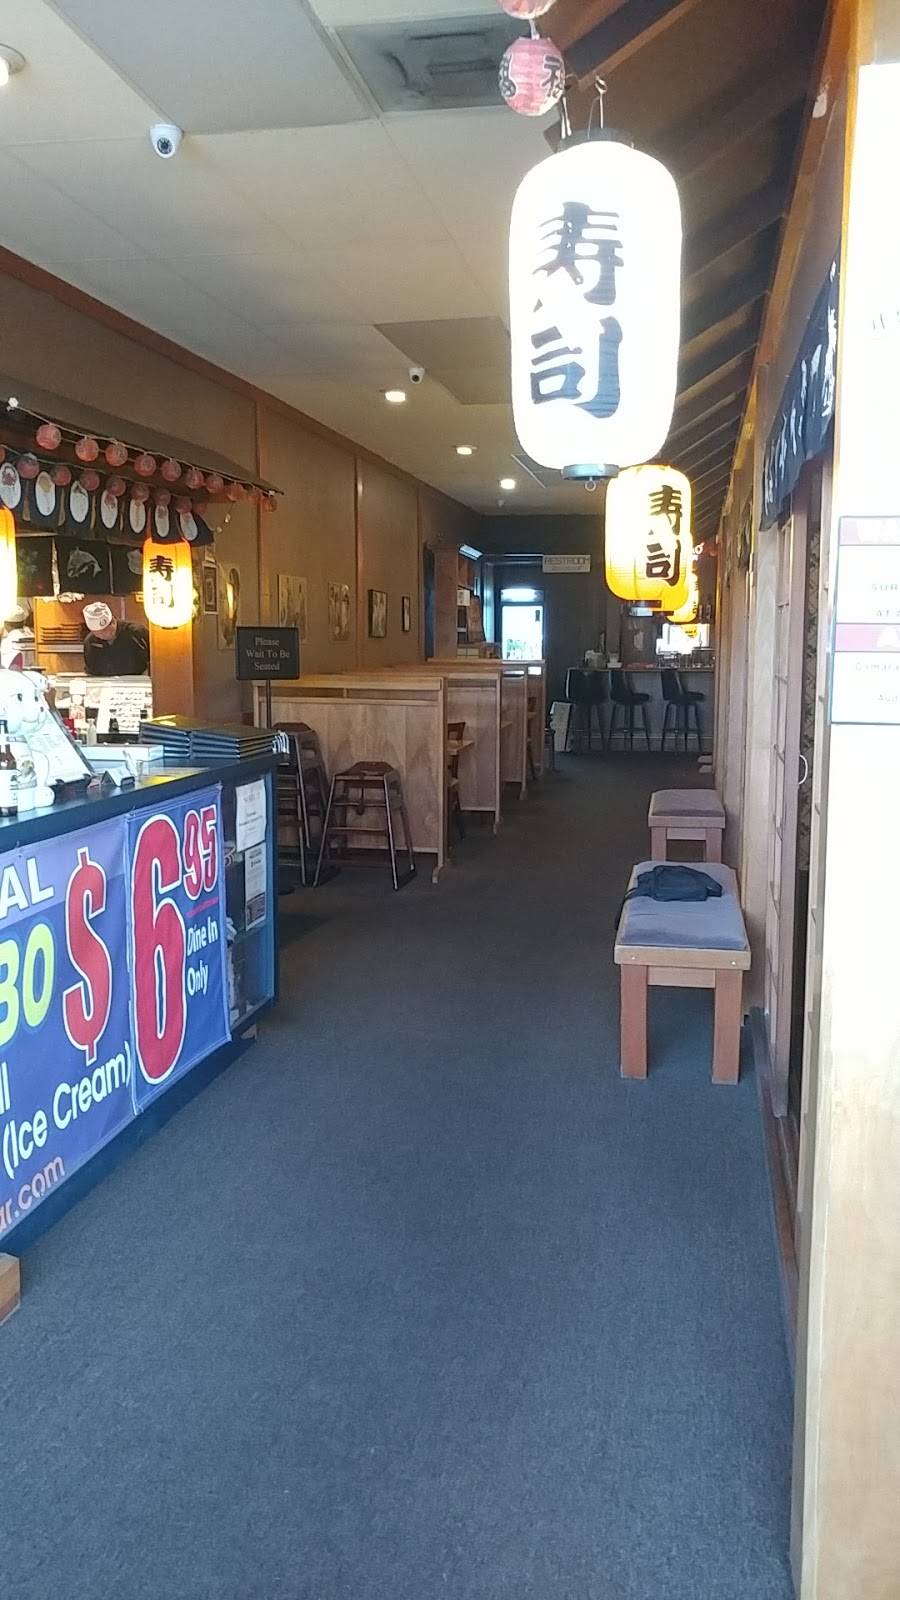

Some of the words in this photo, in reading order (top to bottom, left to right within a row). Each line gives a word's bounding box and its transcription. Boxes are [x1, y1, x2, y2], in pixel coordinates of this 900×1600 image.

[531, 200, 625, 419] 寿司
[645, 484, 683, 587] 寿司
[246, 648, 265, 658] Wait
[267, 649, 278, 658] To
[279, 649, 290, 658] Be
[254, 661, 280, 670] Seated
[255, 637, 280, 646] Please
[0, 857, 55, 921] AL
[131, 814, 187, 1084] 6
[183, 804, 218, 900] 95
[187, 923, 207, 956] Dine
[208, 916, 218, 943] In
[187, 959, 209, 996] Only
[3, 1109, 48, 1179] (Ice
[53, 1040, 131, 1130] Cream)
